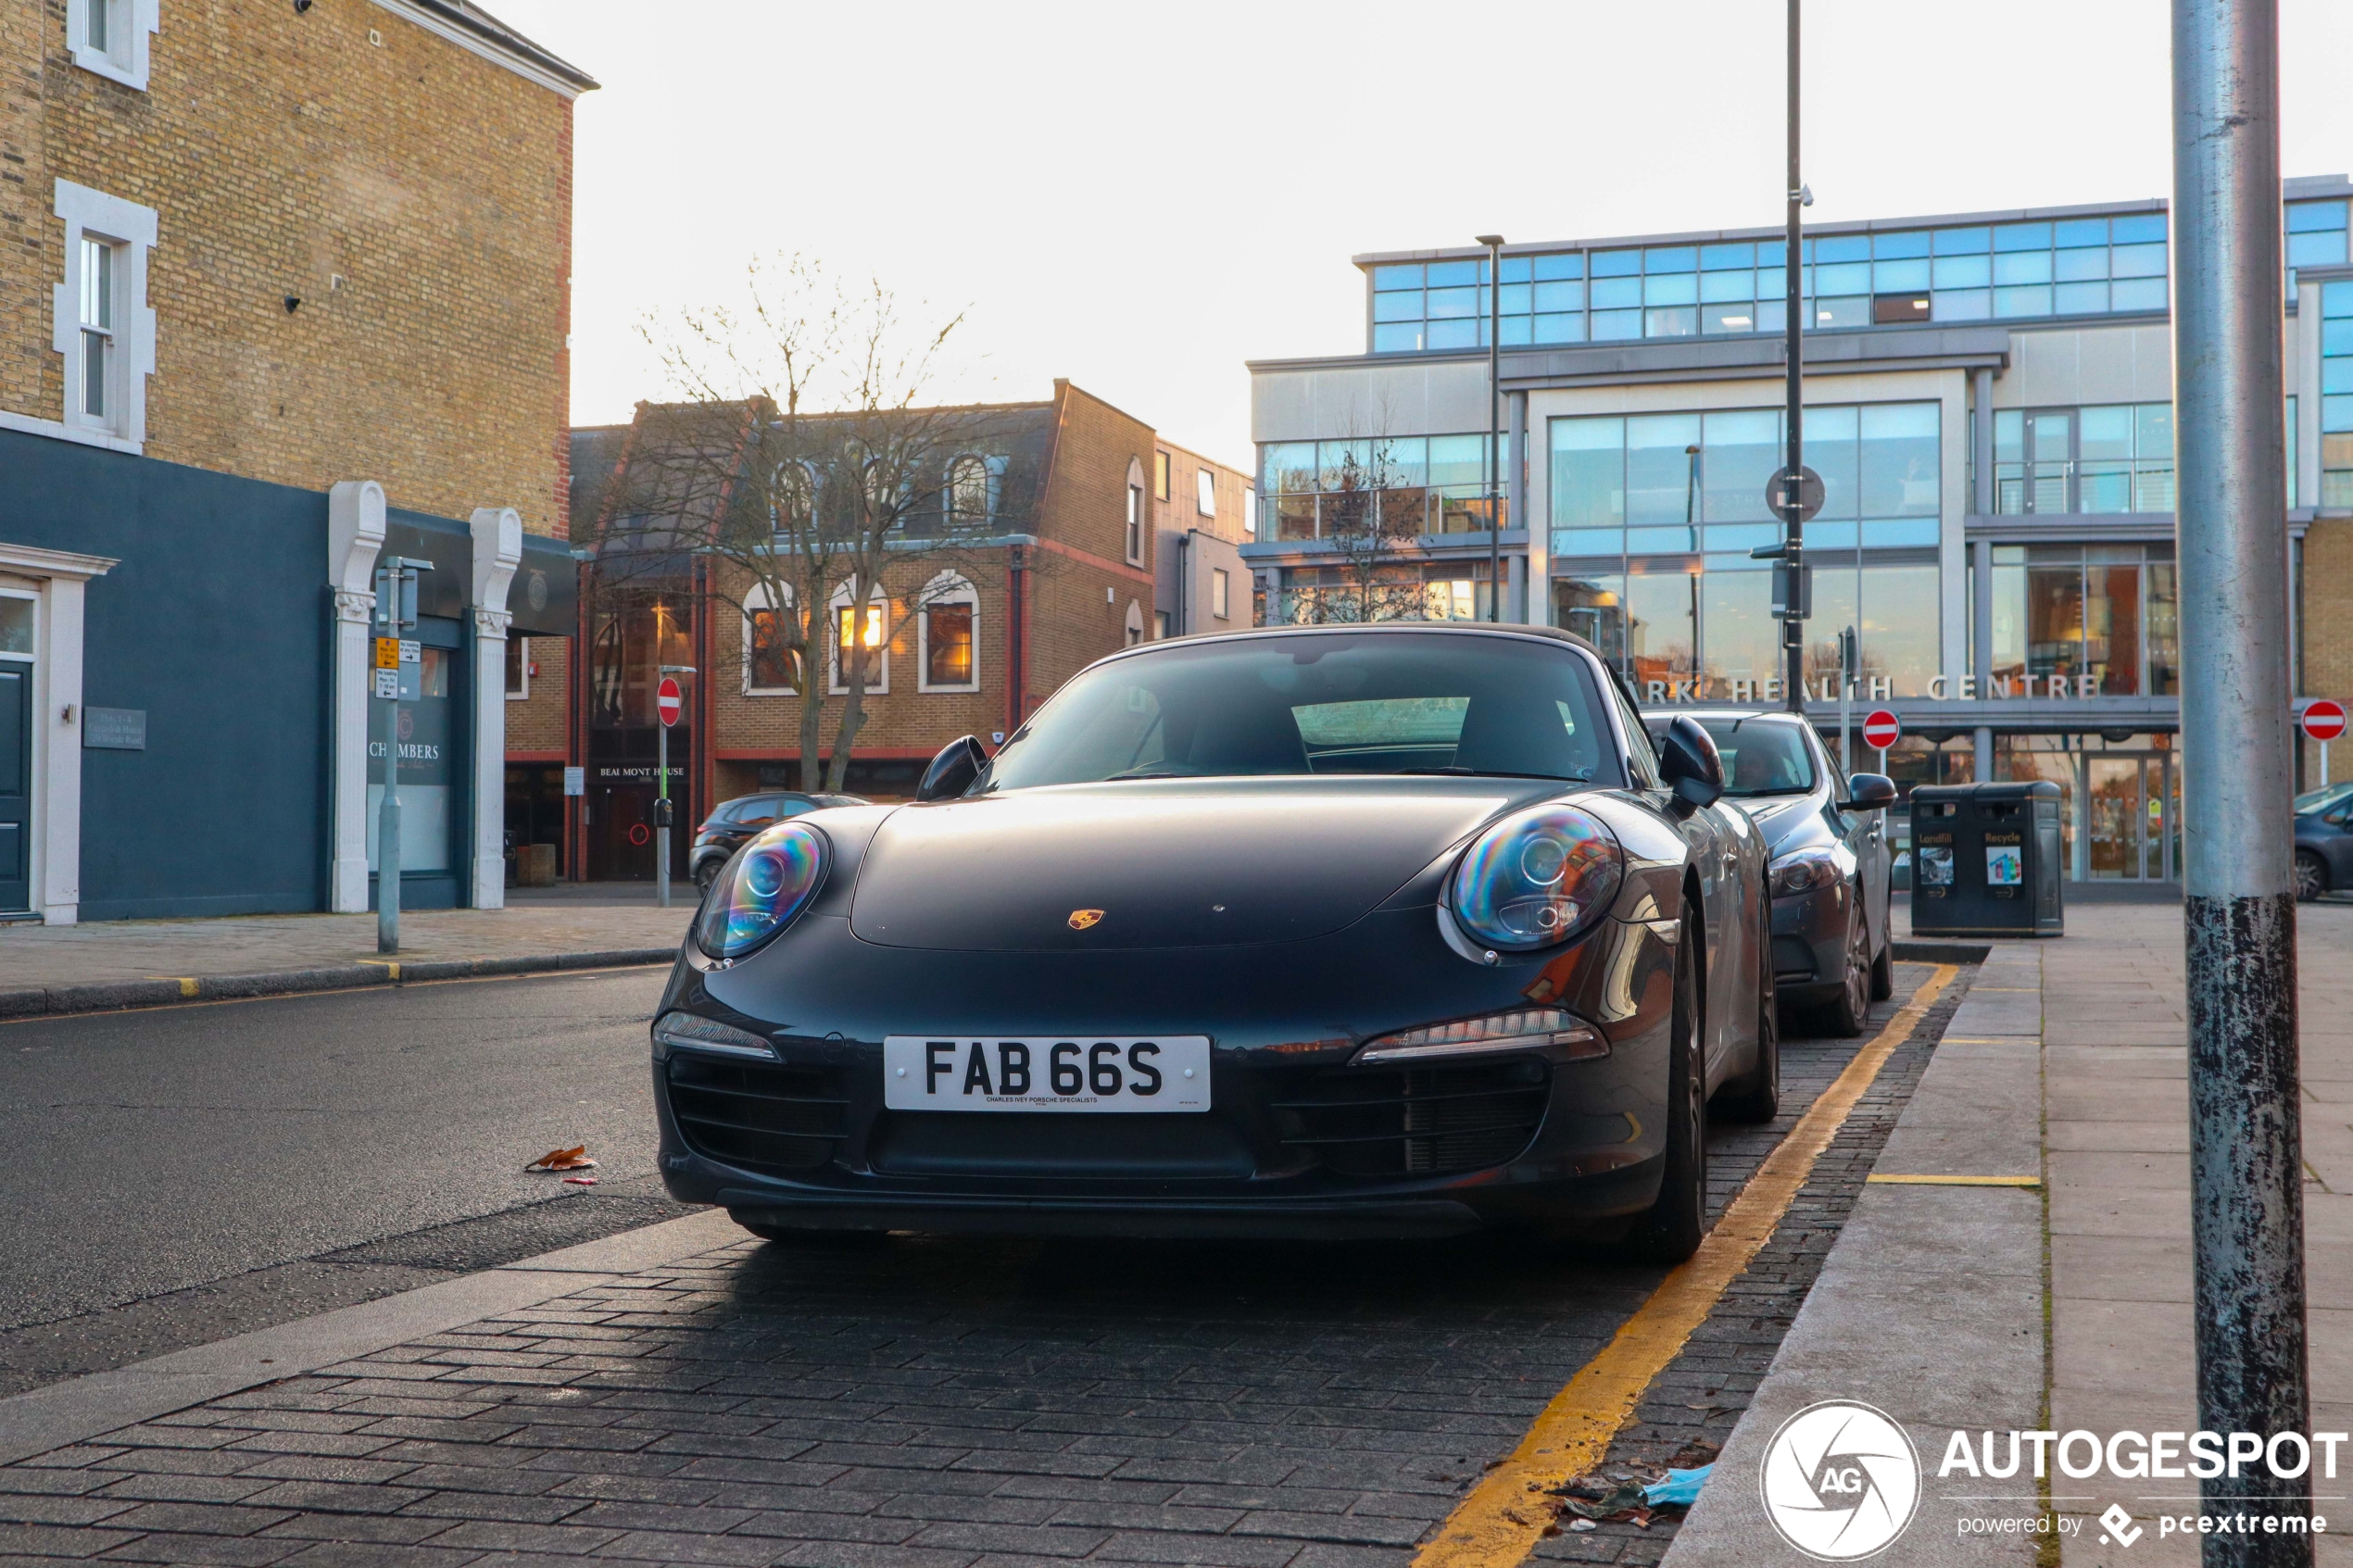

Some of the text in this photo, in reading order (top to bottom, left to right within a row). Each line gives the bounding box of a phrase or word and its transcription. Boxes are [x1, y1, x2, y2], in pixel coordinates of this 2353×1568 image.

[1927, 674, 2096, 700] CENTRE
[369, 742, 439, 759] CHMBERS
[653, 767, 685, 776] HUSE
[1919, 833, 1952, 844] Landfill
[1985, 832, 2020, 844] Recycle
[925, 1042, 1162, 1096] FAB 66S
